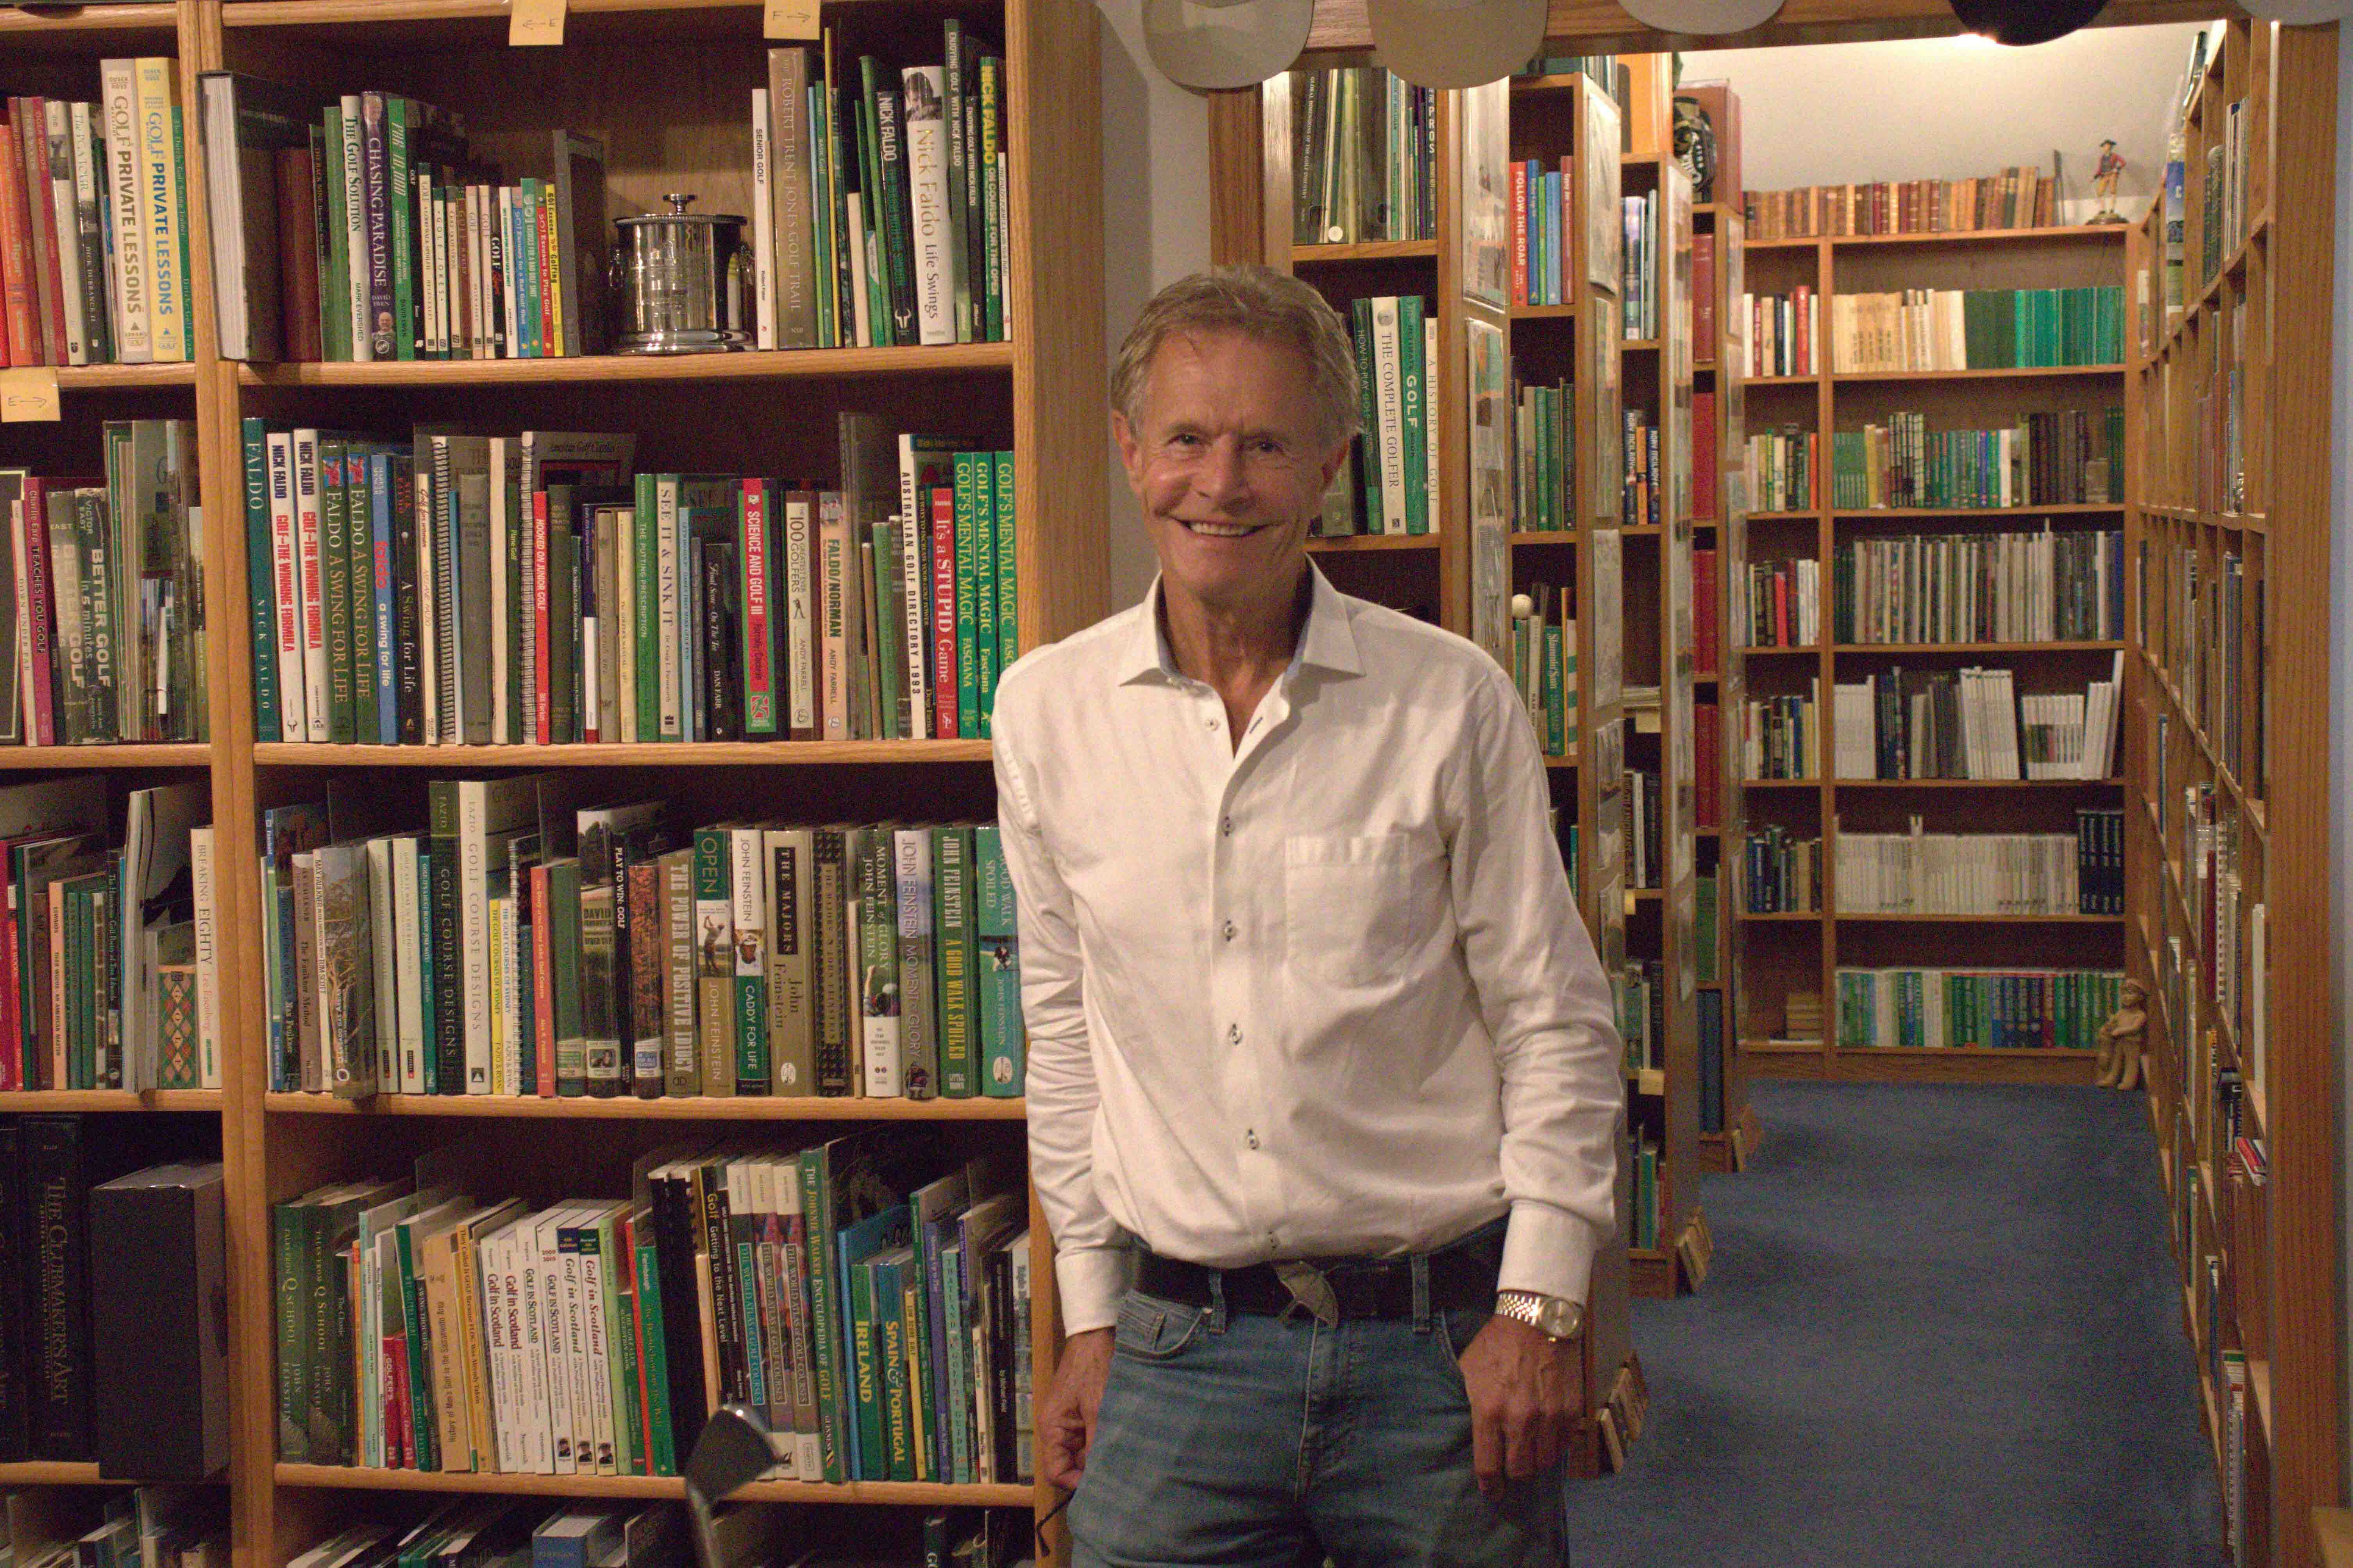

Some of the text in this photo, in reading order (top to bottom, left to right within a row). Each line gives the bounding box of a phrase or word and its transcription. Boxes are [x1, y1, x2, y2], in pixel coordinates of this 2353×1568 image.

[550, 18, 557, 27] E
[772, 11, 783, 21] F
[949, 32, 957, 68] ENJOYING
[951, 97, 959, 117] WITH
[982, 66, 994, 105] NICK
[74, 114, 89, 191] The PGA TOUR
[983, 109, 995, 164] FALDO
[345, 118, 361, 232] THE GOLF SOLUTION
[782, 78, 801, 310] ROBERT TRENT JONES GOLF TRAIL
[988, 167, 994, 178] ON
[113, 96, 140, 313] GOLF PRIVATE LESSONS
[148, 112, 172, 315] GOLF PRIVATE LESSONS
[368, 138, 386, 286] CHASING PARADISE
[916, 129, 940, 318] Nick Faldo Life Swings
[492, 237, 501, 269] GOLF
[991, 266, 999, 295] OPEN
[1382, 333, 1400, 488] THE COMPLETE GOLFER
[1407, 375, 1417, 428] GOLF
[1428, 375, 1437, 432] HISTORY
[246, 443, 262, 510] FALDO
[273, 445, 285, 469] NICK
[1429, 443, 1438, 460] OF
[274, 471, 287, 498] FALDO
[1430, 469, 1438, 504] GOLF
[30, 523, 39, 542] Earp
[978, 521, 990, 580] MENTAL
[279, 563, 293, 605] WINNING
[375, 541, 389, 588] faldo
[536, 519, 546, 611] HOOKED ON JUNIOR GOLF
[747, 511, 763, 614] SCIENCE AND GOLF III
[828, 539, 841, 637] FALDO/NORMAN
[902, 472, 921, 694] AUSTRALIAN GOLF DIRECTORY 1993
[35, 599, 43, 622] YOU
[81, 580, 95, 659] in 5 minutes
[92, 549, 110, 687] BETTER GOLF
[327, 492, 348, 703] FALDO A SWING FOR LIFE
[937, 559, 952, 632] STUPID
[979, 585, 991, 634] MAGIC
[37, 626, 45, 653] GOLF
[281, 608, 295, 652] FORMULA
[378, 614, 390, 648] swing
[381, 651, 391, 666] for
[382, 669, 392, 686] life
[938, 639, 951, 683] Game
[981, 648, 991, 693] Fasciana
[616, 871, 623, 882] TO
[943, 836, 960, 864] JOHN
[440, 868, 451, 909] GOLF
[781, 852, 792, 952] THE MAJORS
[943, 868, 961, 928] FEINSTEIN
[197, 844, 213, 1032] BREAKING EIGHTY Lee Eisenberg
[442, 918, 453, 980] COURSE
[701, 838, 721, 1080] OPEN JOHN FEINSTEIN
[741, 839, 757, 1070] JOHN FEINSTEIN CADDY FOR LIFE
[946, 949, 963, 975] GOOD
[947, 980, 965, 1010] WALK
[444, 989, 456, 1057] DESIGNS
[948, 1014, 966, 1059] SPOILED
[585, 1260, 603, 1356] Golf in Scotland
[805, 1166, 831, 1401] THE JOHNNIE WALKER ENCYCLOPEDIA OF GOLF
[855, 1321, 873, 1403] IRELAND
[885, 1321, 906, 1464] SPAIN & PORTUGAL
[824, 1415, 833, 1450] GUINNESS
